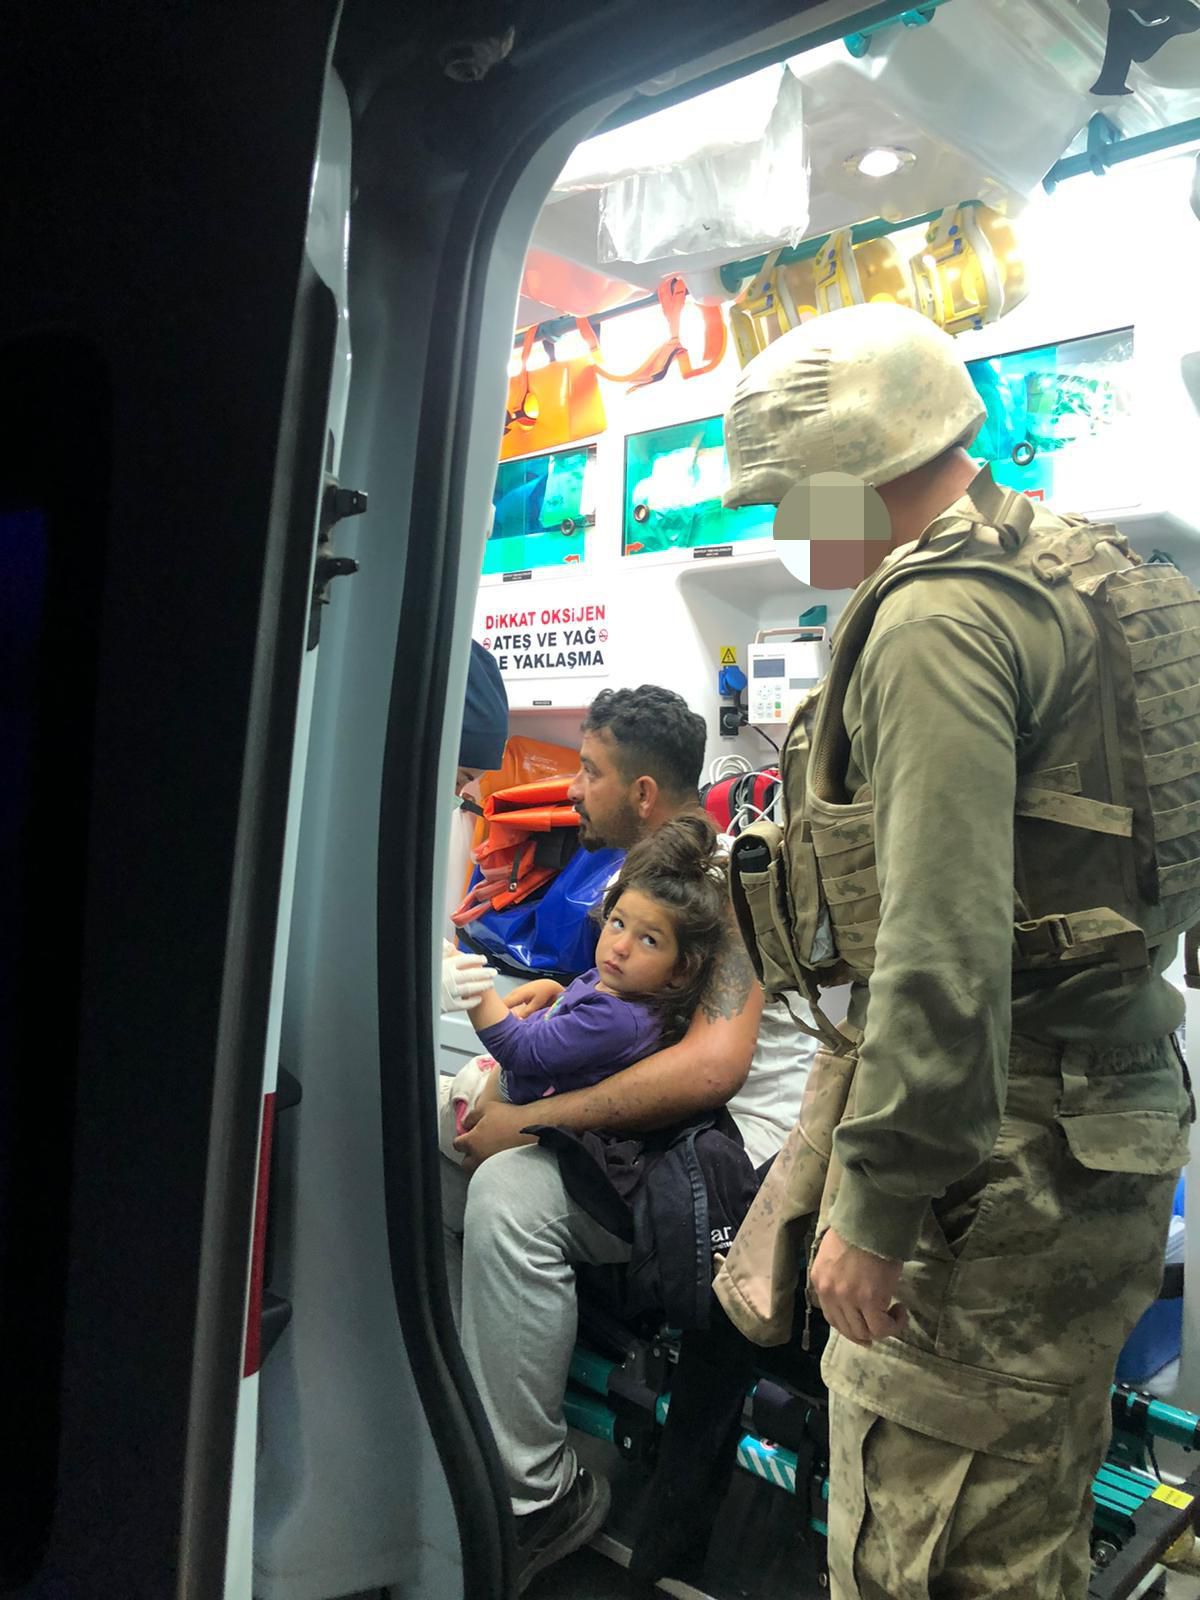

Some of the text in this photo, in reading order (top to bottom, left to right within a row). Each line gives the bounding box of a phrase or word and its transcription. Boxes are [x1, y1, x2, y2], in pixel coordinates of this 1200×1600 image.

[493, 626, 596, 651] ATEŞ VE YAĞ
[499, 650, 604, 670] E YAKLAŞMA
[710, 1226, 732, 1242] ar
